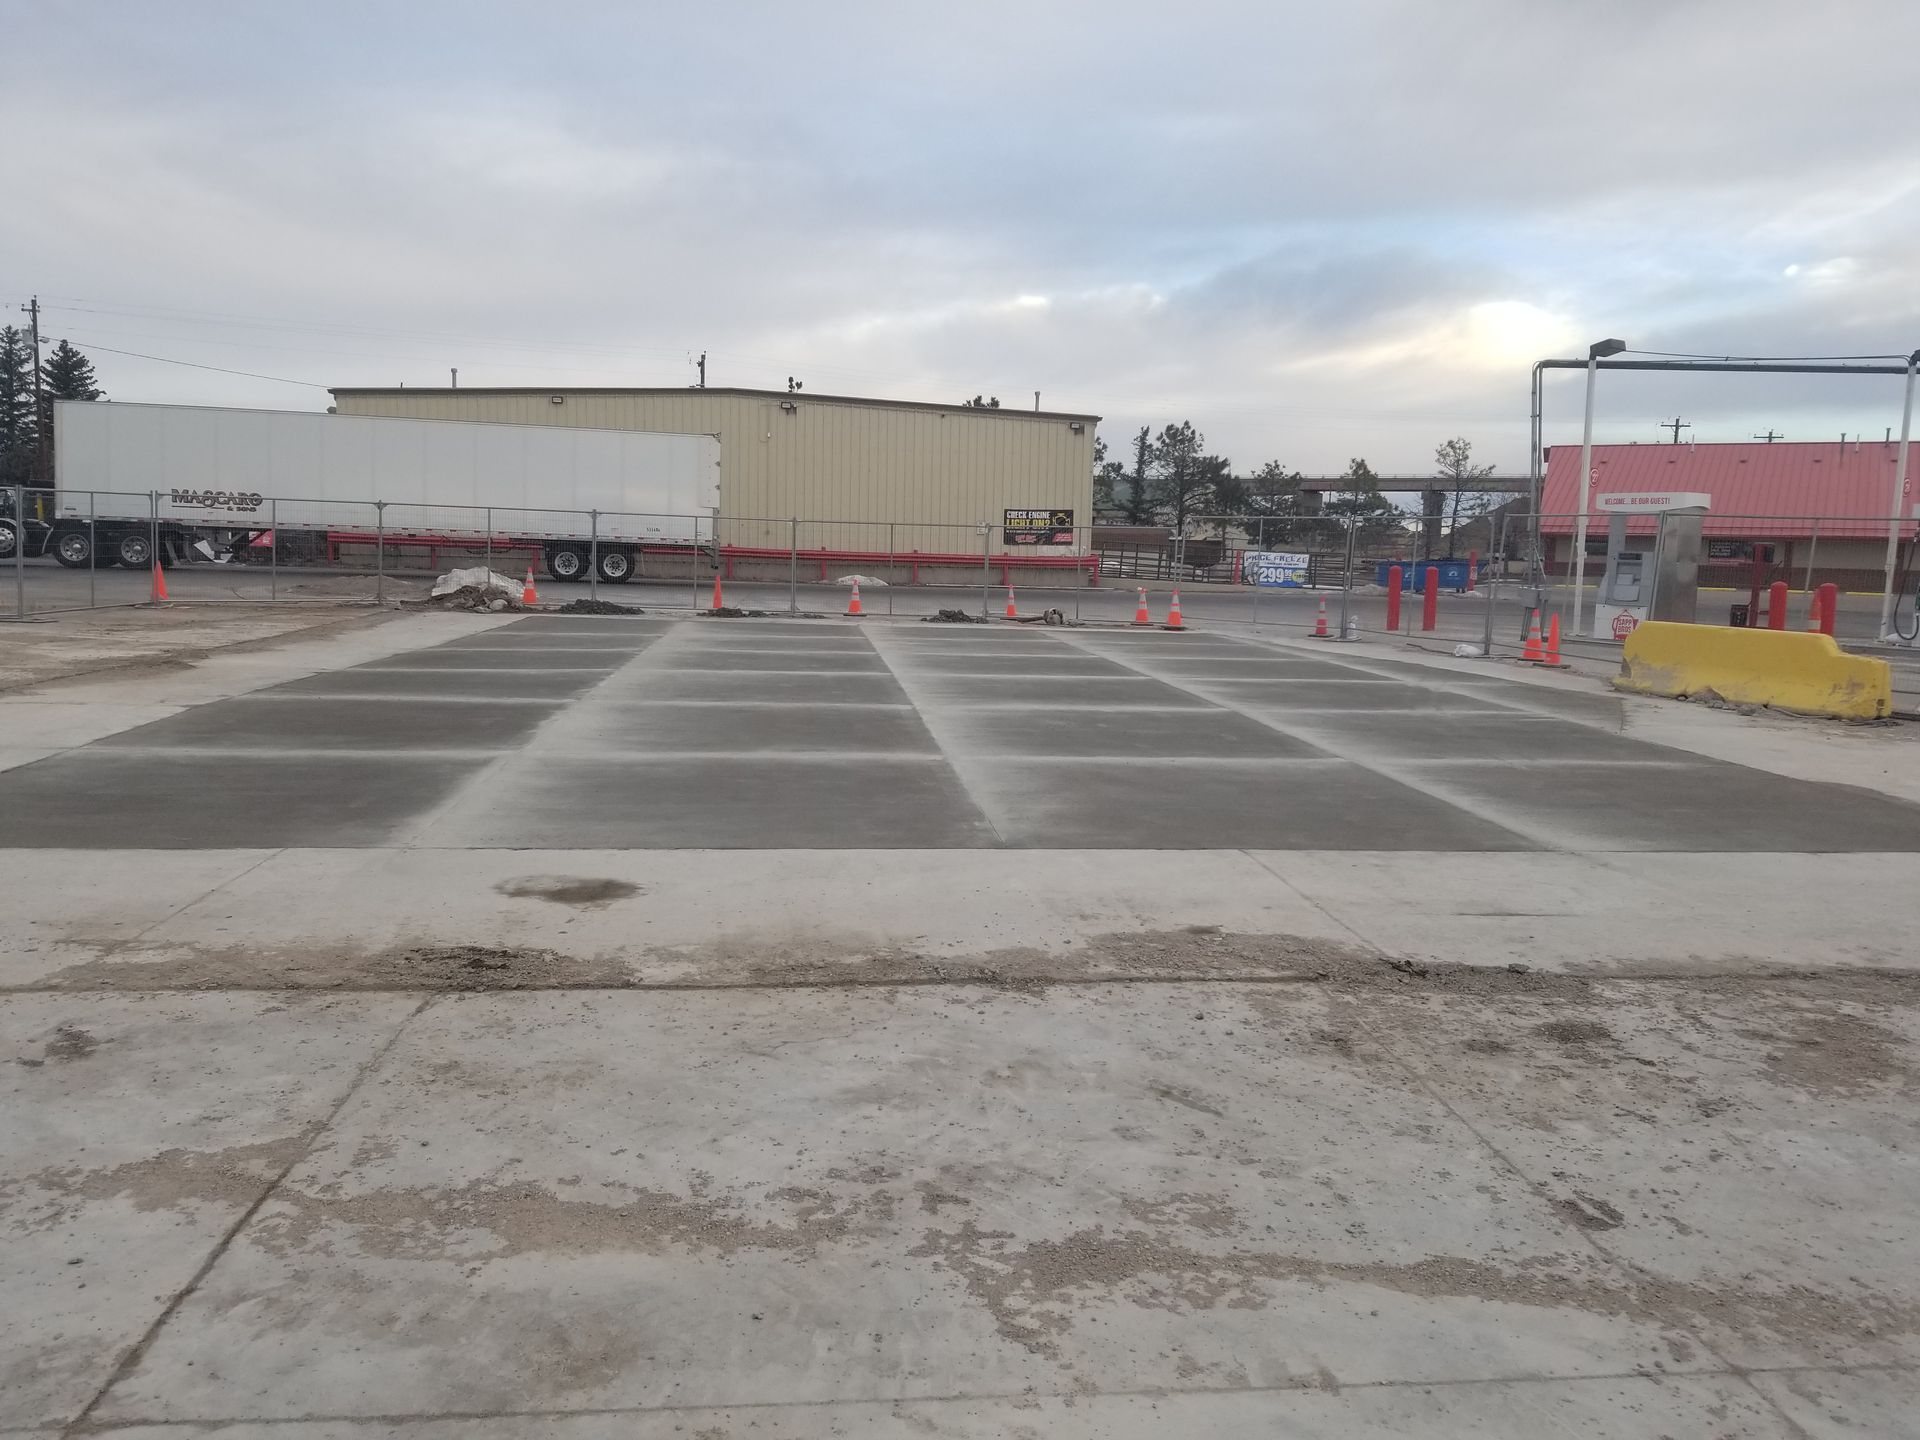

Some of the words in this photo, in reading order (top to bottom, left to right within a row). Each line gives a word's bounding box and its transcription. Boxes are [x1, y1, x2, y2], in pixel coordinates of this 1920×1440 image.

[171, 489, 263, 507] MASCARO
[1631, 497, 1638, 505] BE
[1638, 497, 1649, 505] OUR
[1650, 497, 1670, 505] GUEST!
[1007, 511, 1027, 519] CHECK
[1029, 511, 1051, 519] ENGINE
[1033, 519, 1051, 527] ON?
[1246, 554, 1271, 562] PRICE
[1274, 555, 1308, 563] FREEZE
